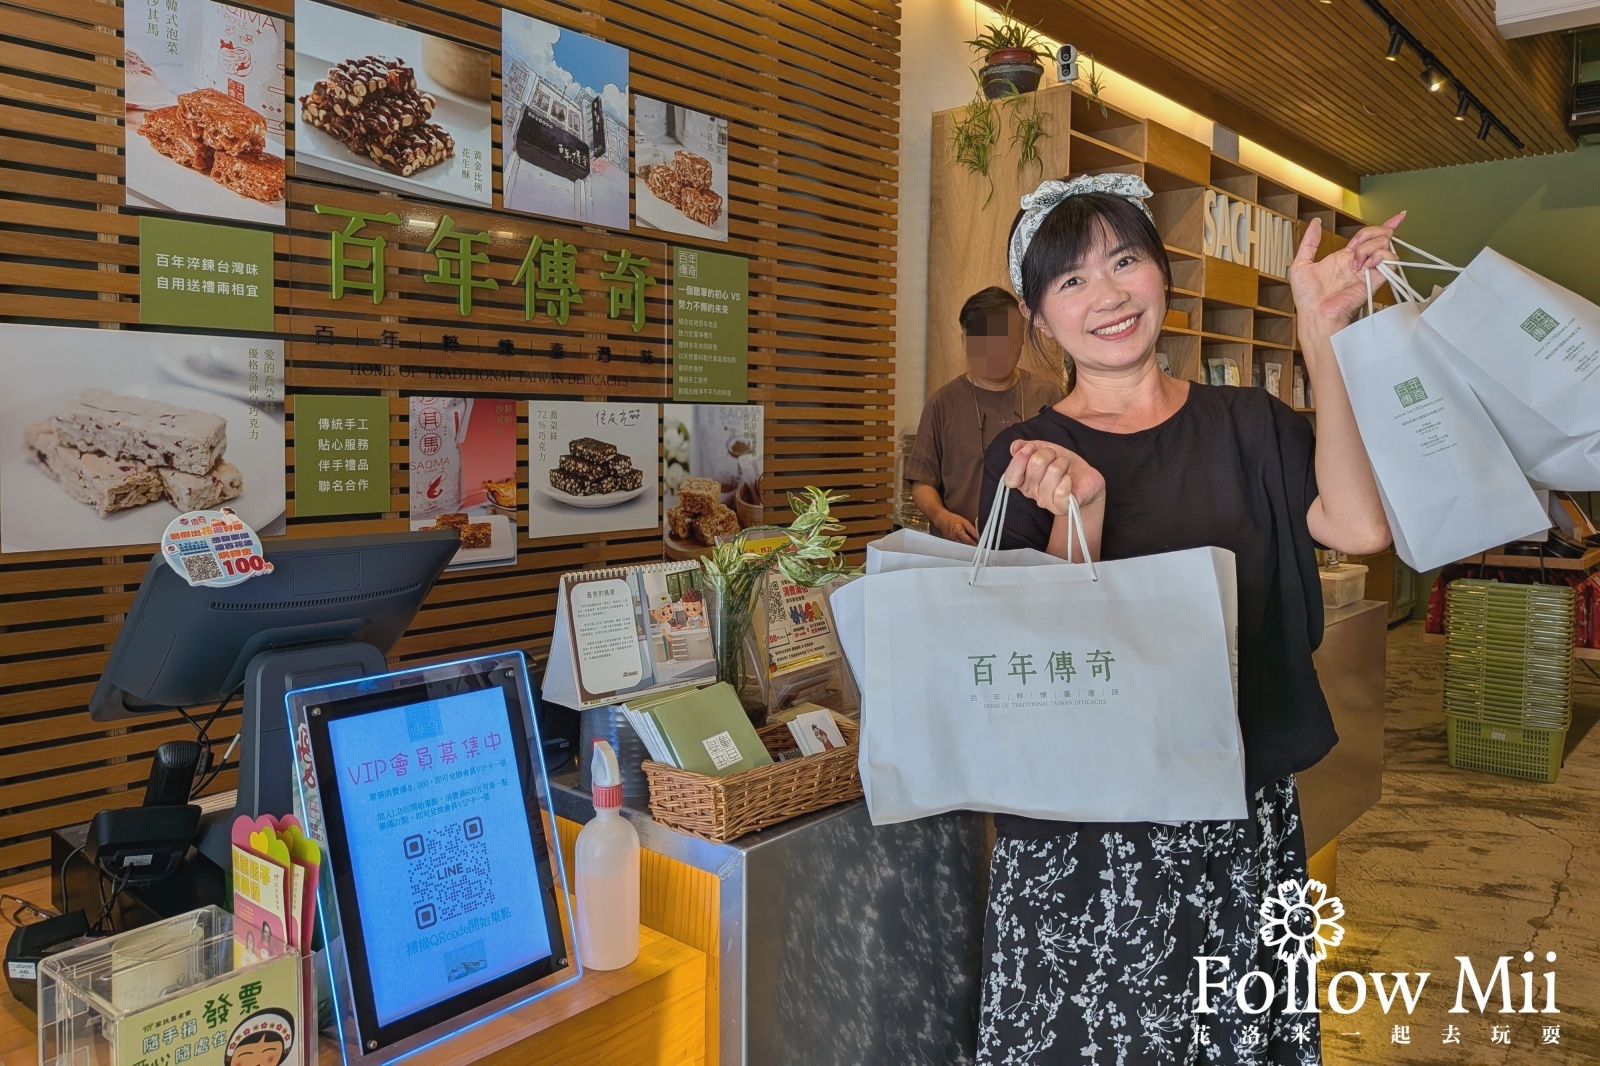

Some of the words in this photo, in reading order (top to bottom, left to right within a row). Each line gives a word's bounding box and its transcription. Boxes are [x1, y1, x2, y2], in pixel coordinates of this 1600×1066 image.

[461, 148, 471, 179] 花生酥
[473, 150, 483, 192] 黃金比例
[1203, 189, 1294, 279] SACHIMA
[155, 252, 260, 277] 百年淬鍊台灣味
[314, 204, 656, 333] 百年傳奇
[156, 275, 260, 299] 自用送禮兩相宜
[731, 292, 741, 301] VS
[678, 300, 729, 314] 努力不懈的未來
[350, 362, 395, 377] HOME
[427, 369, 515, 383] TRADITIONAL
[517, 372, 565, 385] TAIWAN
[567, 374, 629, 387] DELICACIES
[248, 348, 260, 440] 優格洛神白巧克力
[318, 417, 369, 431] 傳統手工
[318, 438, 369, 451] 貼心服務
[318, 458, 369, 472] 伴手禮品
[410, 456, 450, 471] SAQIMA
[318, 479, 369, 492] 聯名合作
[967, 648, 1116, 687] 百年傳奇
[1012, 701, 1050, 709] TRADITIONAL
[347, 731, 502, 787] VIP會員募集中
[436, 862, 464, 881] LINE
[143, 1019, 198, 1055] 隨手捐
[202, 980, 262, 1030] 發票
[155, 1009, 191, 1029] 家扶基金會
[174, 1030, 228, 1064] 隨處在
